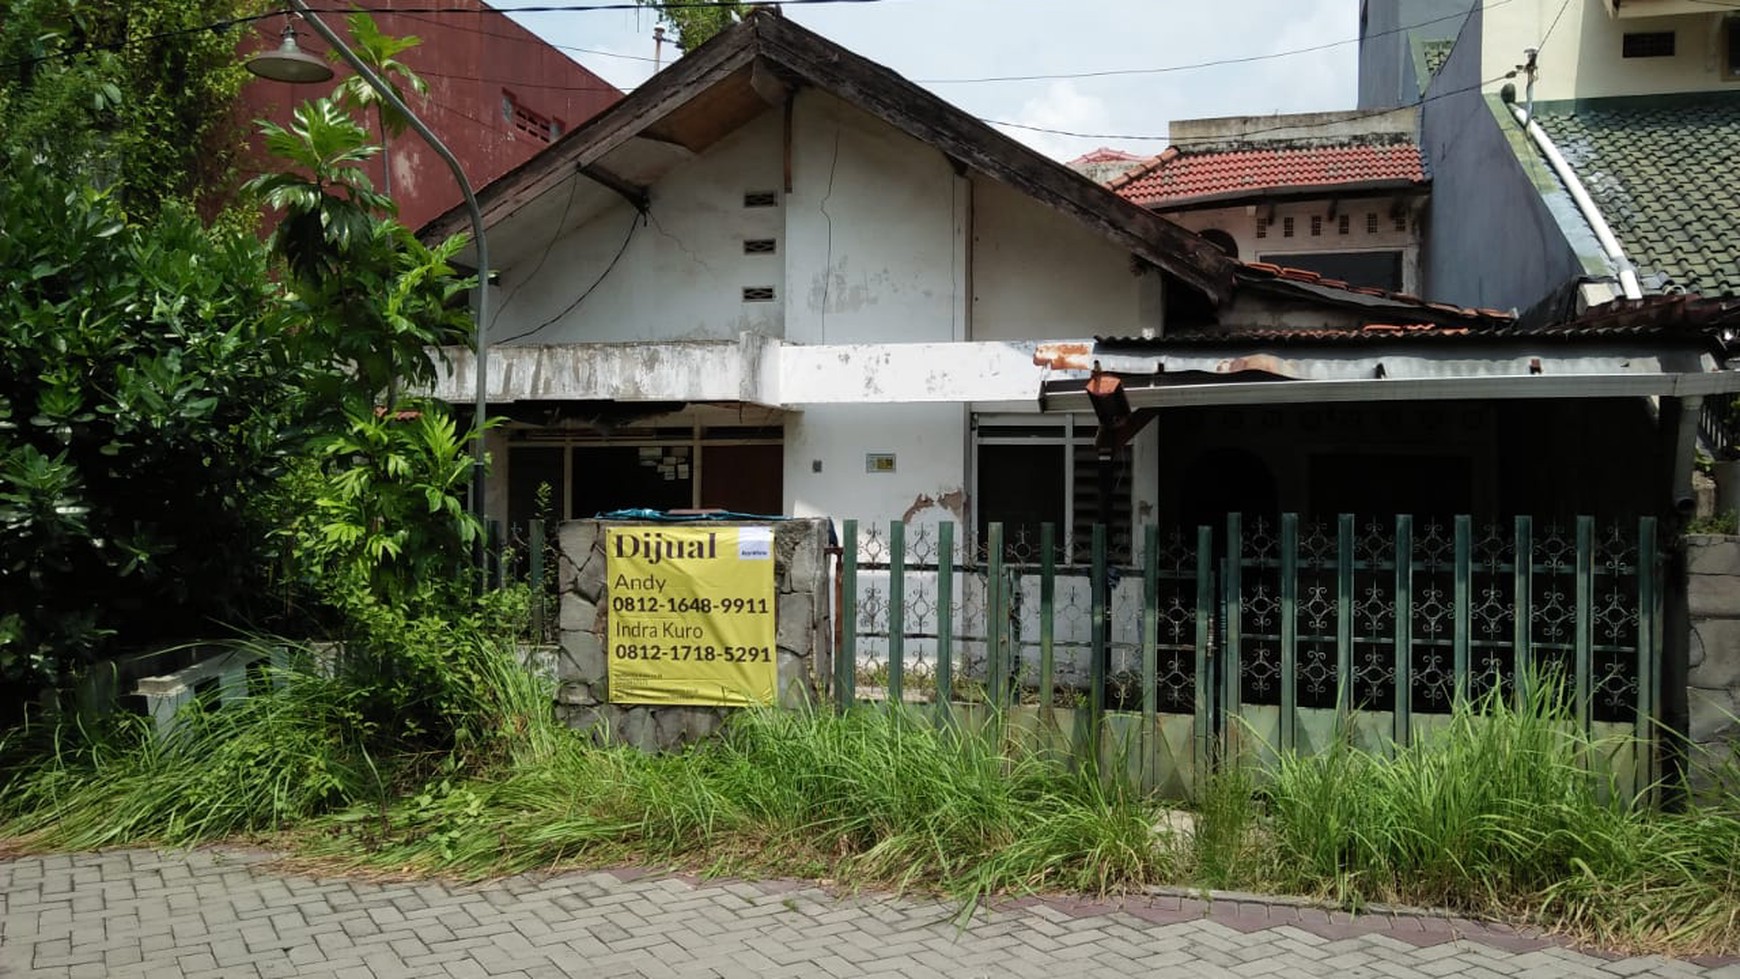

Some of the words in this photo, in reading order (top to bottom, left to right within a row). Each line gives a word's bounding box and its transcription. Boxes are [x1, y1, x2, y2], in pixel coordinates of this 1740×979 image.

[615, 533, 717, 564] Dijual
[614, 574, 667, 592] Andy
[613, 597, 769, 614] 0812-1648-9911
[616, 622, 657, 638] Indra
[662, 622, 703, 638] Kuro
[616, 644, 772, 662] 0812-1718-5291
